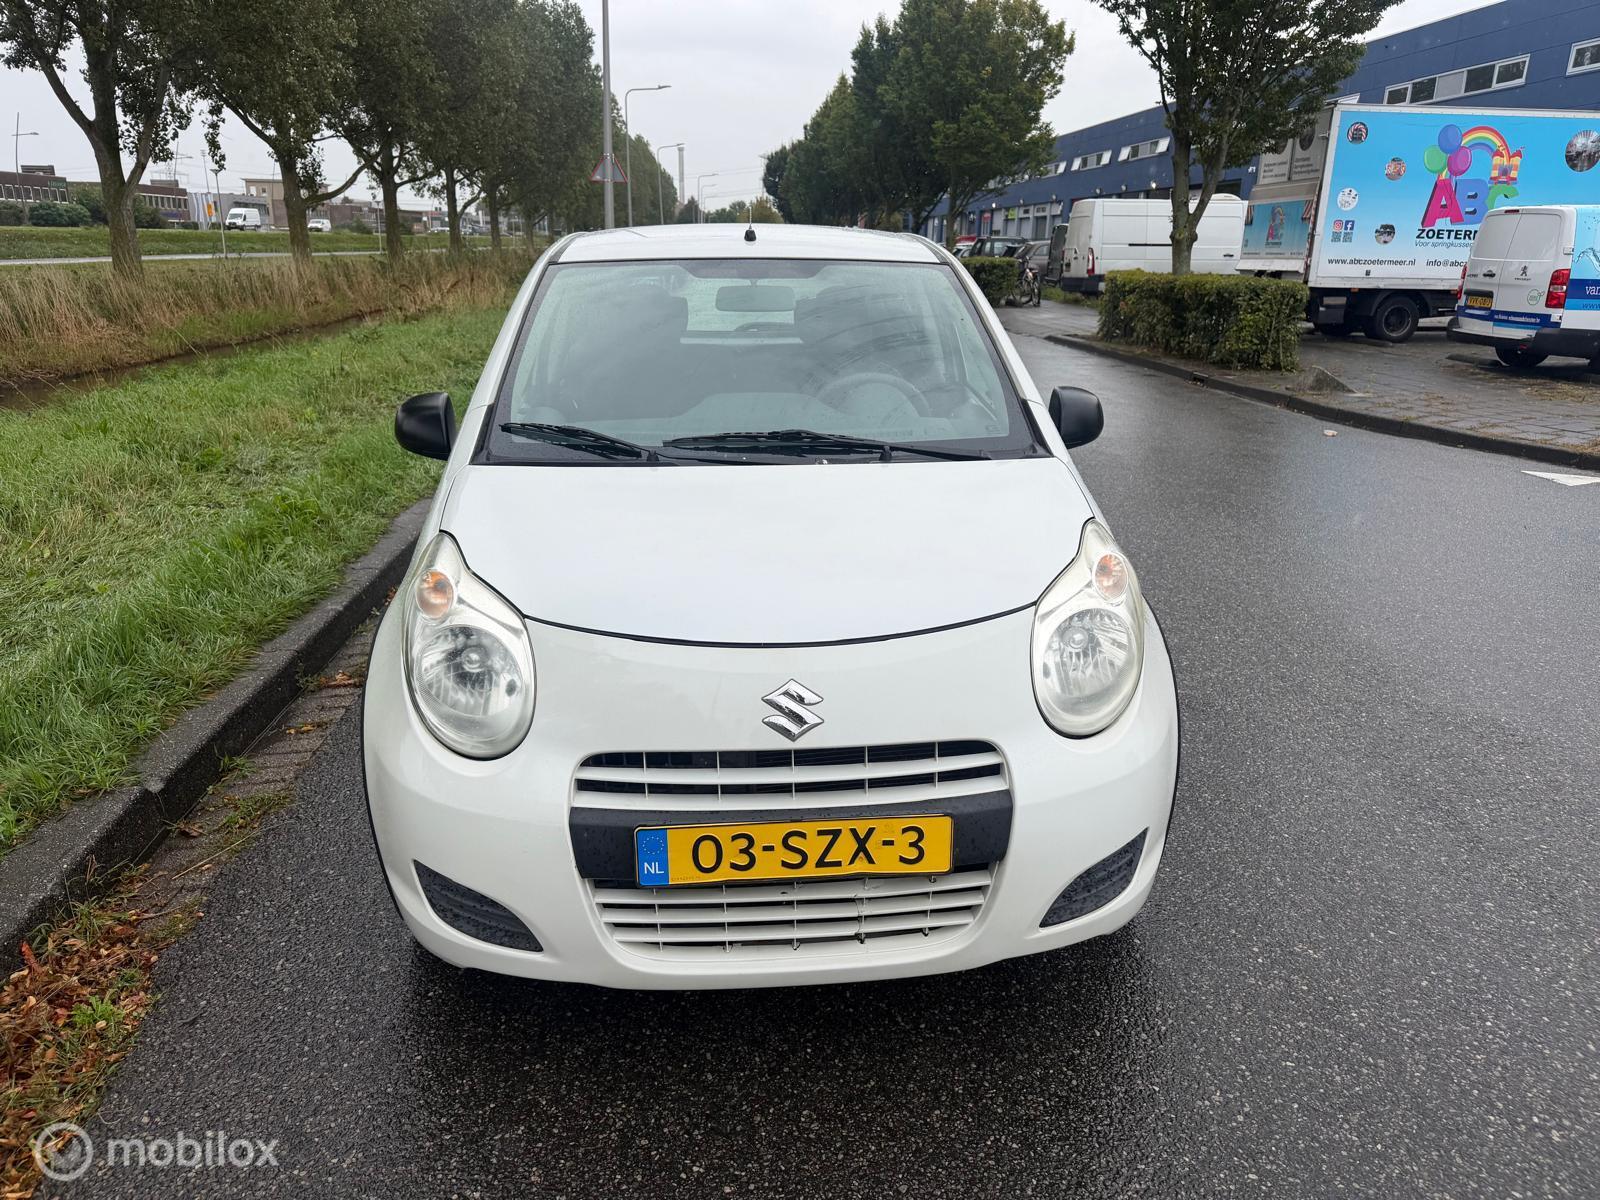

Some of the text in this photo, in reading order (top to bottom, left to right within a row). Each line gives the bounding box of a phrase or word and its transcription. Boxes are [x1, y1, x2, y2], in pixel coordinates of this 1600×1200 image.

[1327, 258, 1416, 266] www.abczoetermeer.nl
[1426, 259, 1467, 267] info@abc
[692, 825, 925, 874] 03-SZX-3
[644, 862, 664, 875] NL
